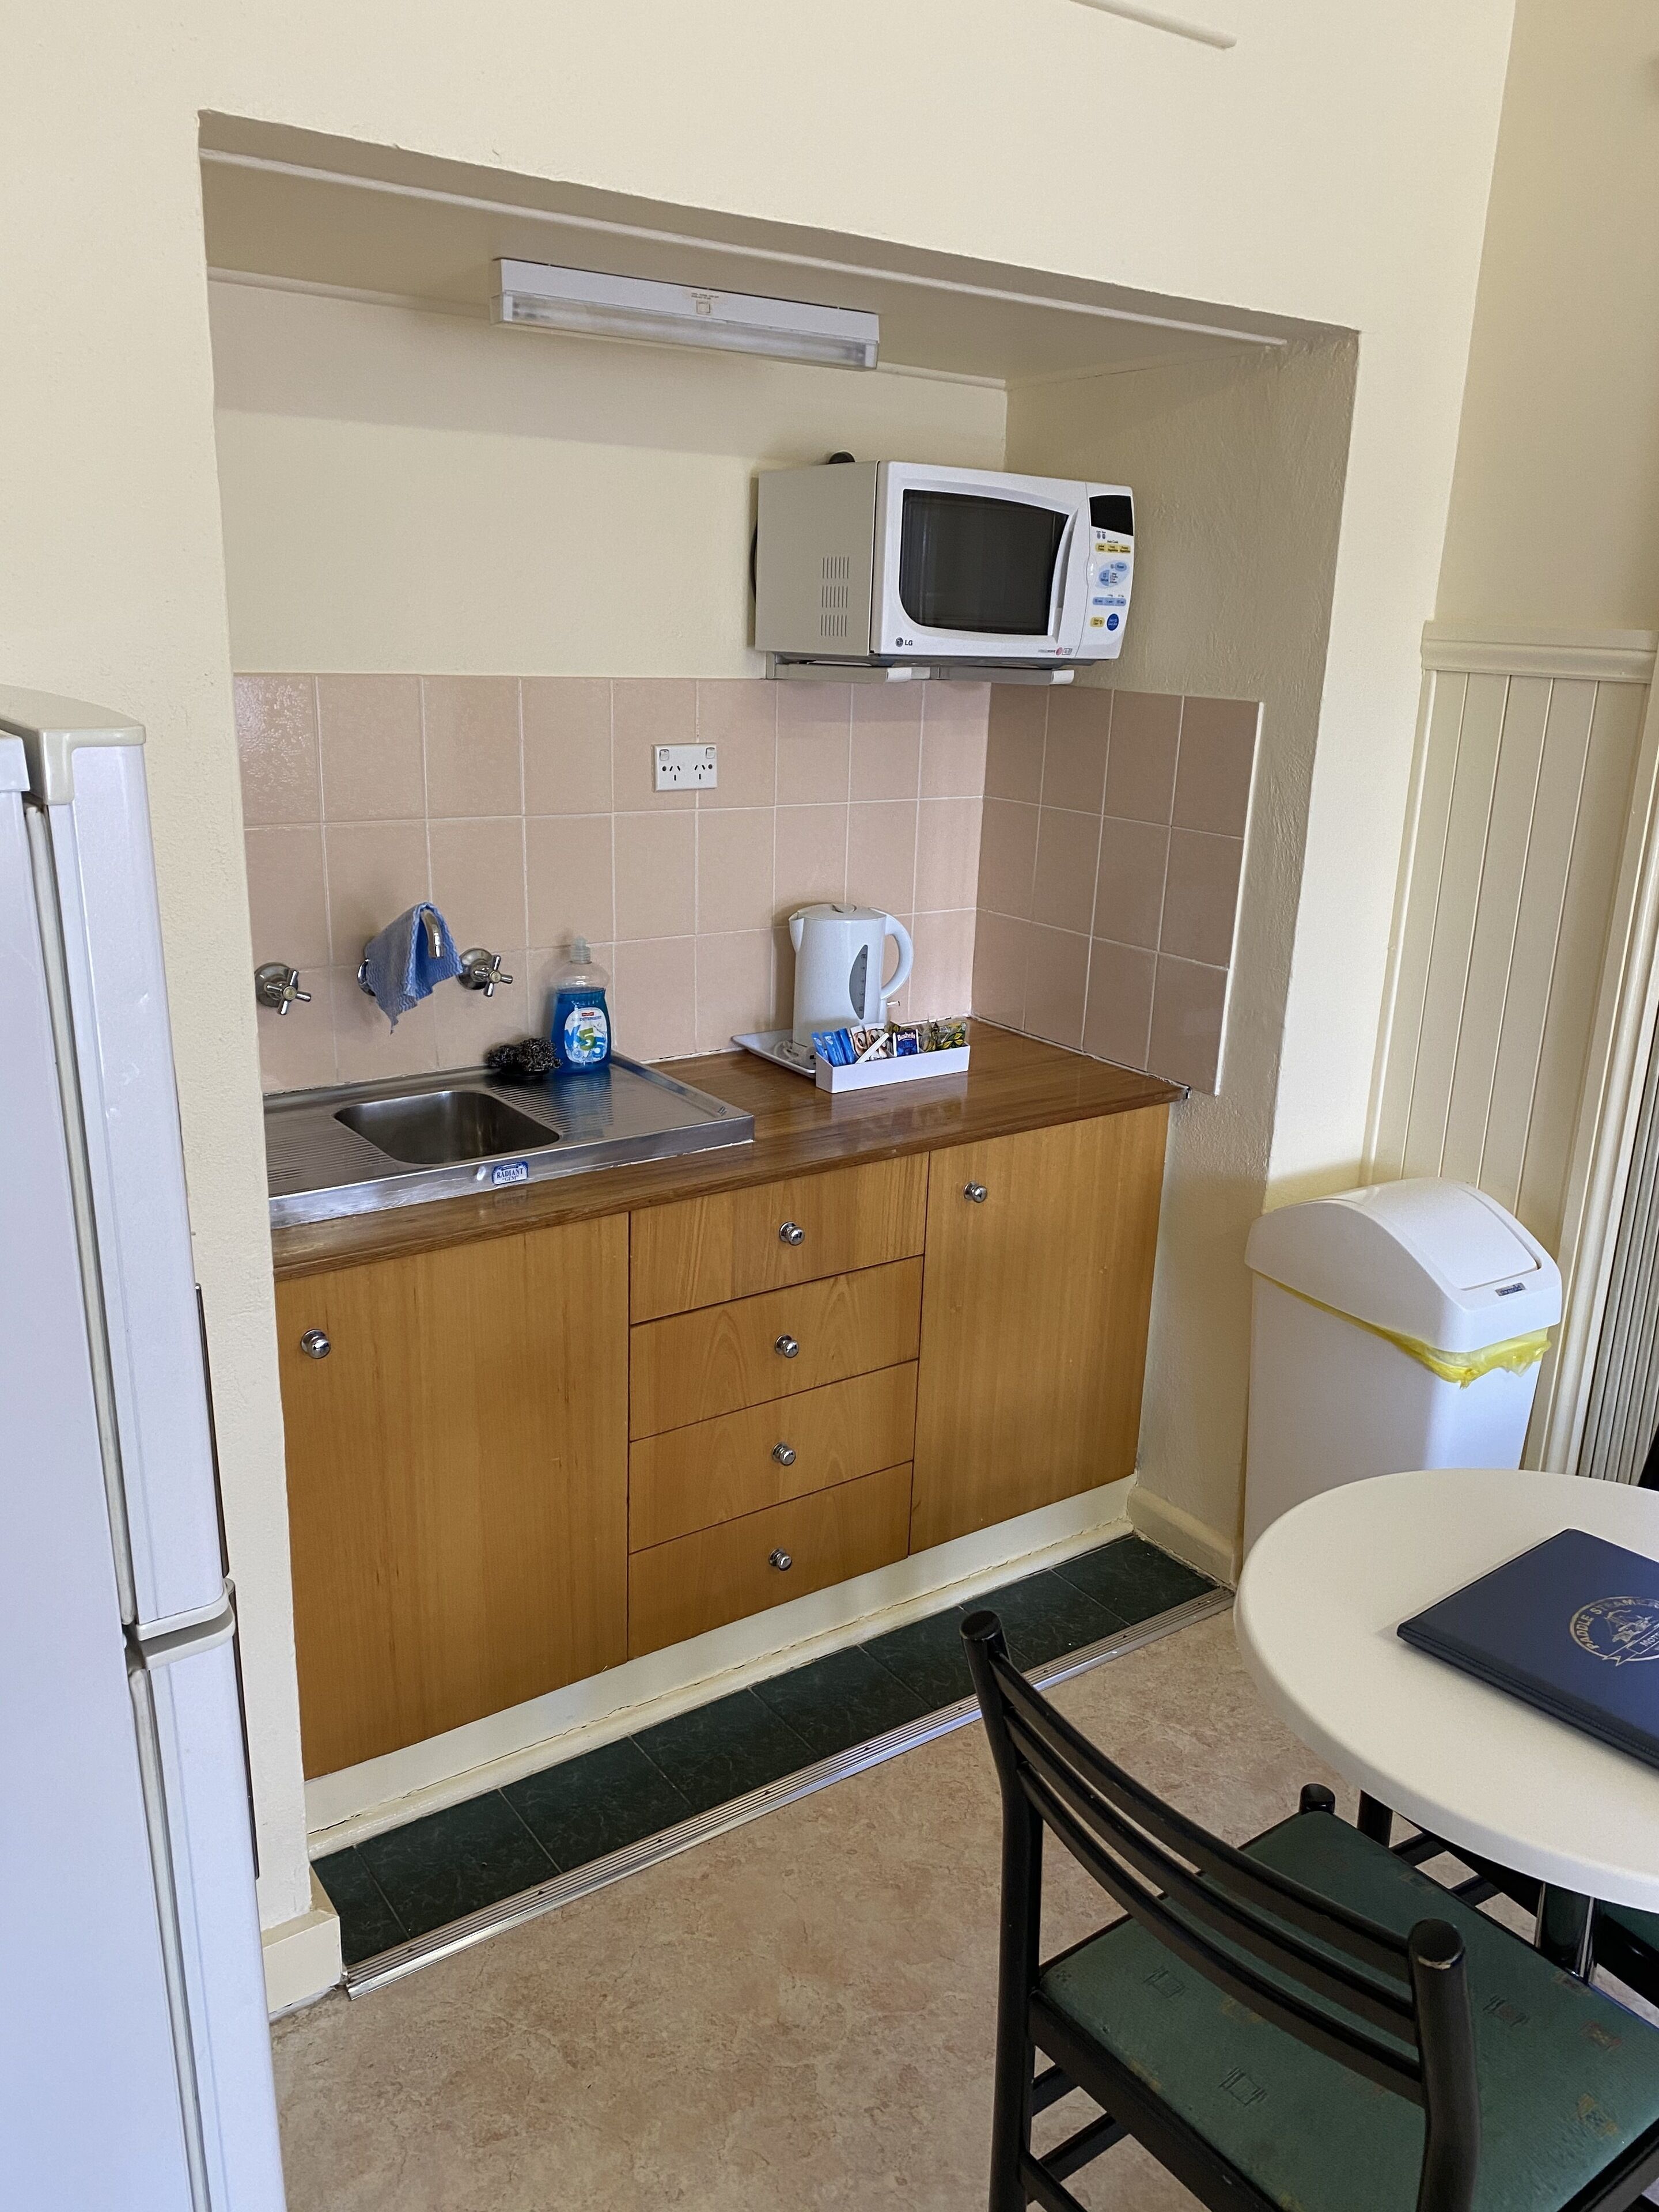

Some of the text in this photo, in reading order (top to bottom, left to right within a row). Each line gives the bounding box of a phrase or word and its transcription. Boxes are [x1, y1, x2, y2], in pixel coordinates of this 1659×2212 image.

[897, 1032, 916, 1041] Bushells
[497, 1168, 523, 1179] RADIANT
[1575, 1615, 1600, 1650] PADDLE
[1639, 1631, 1659, 1647] MOT
